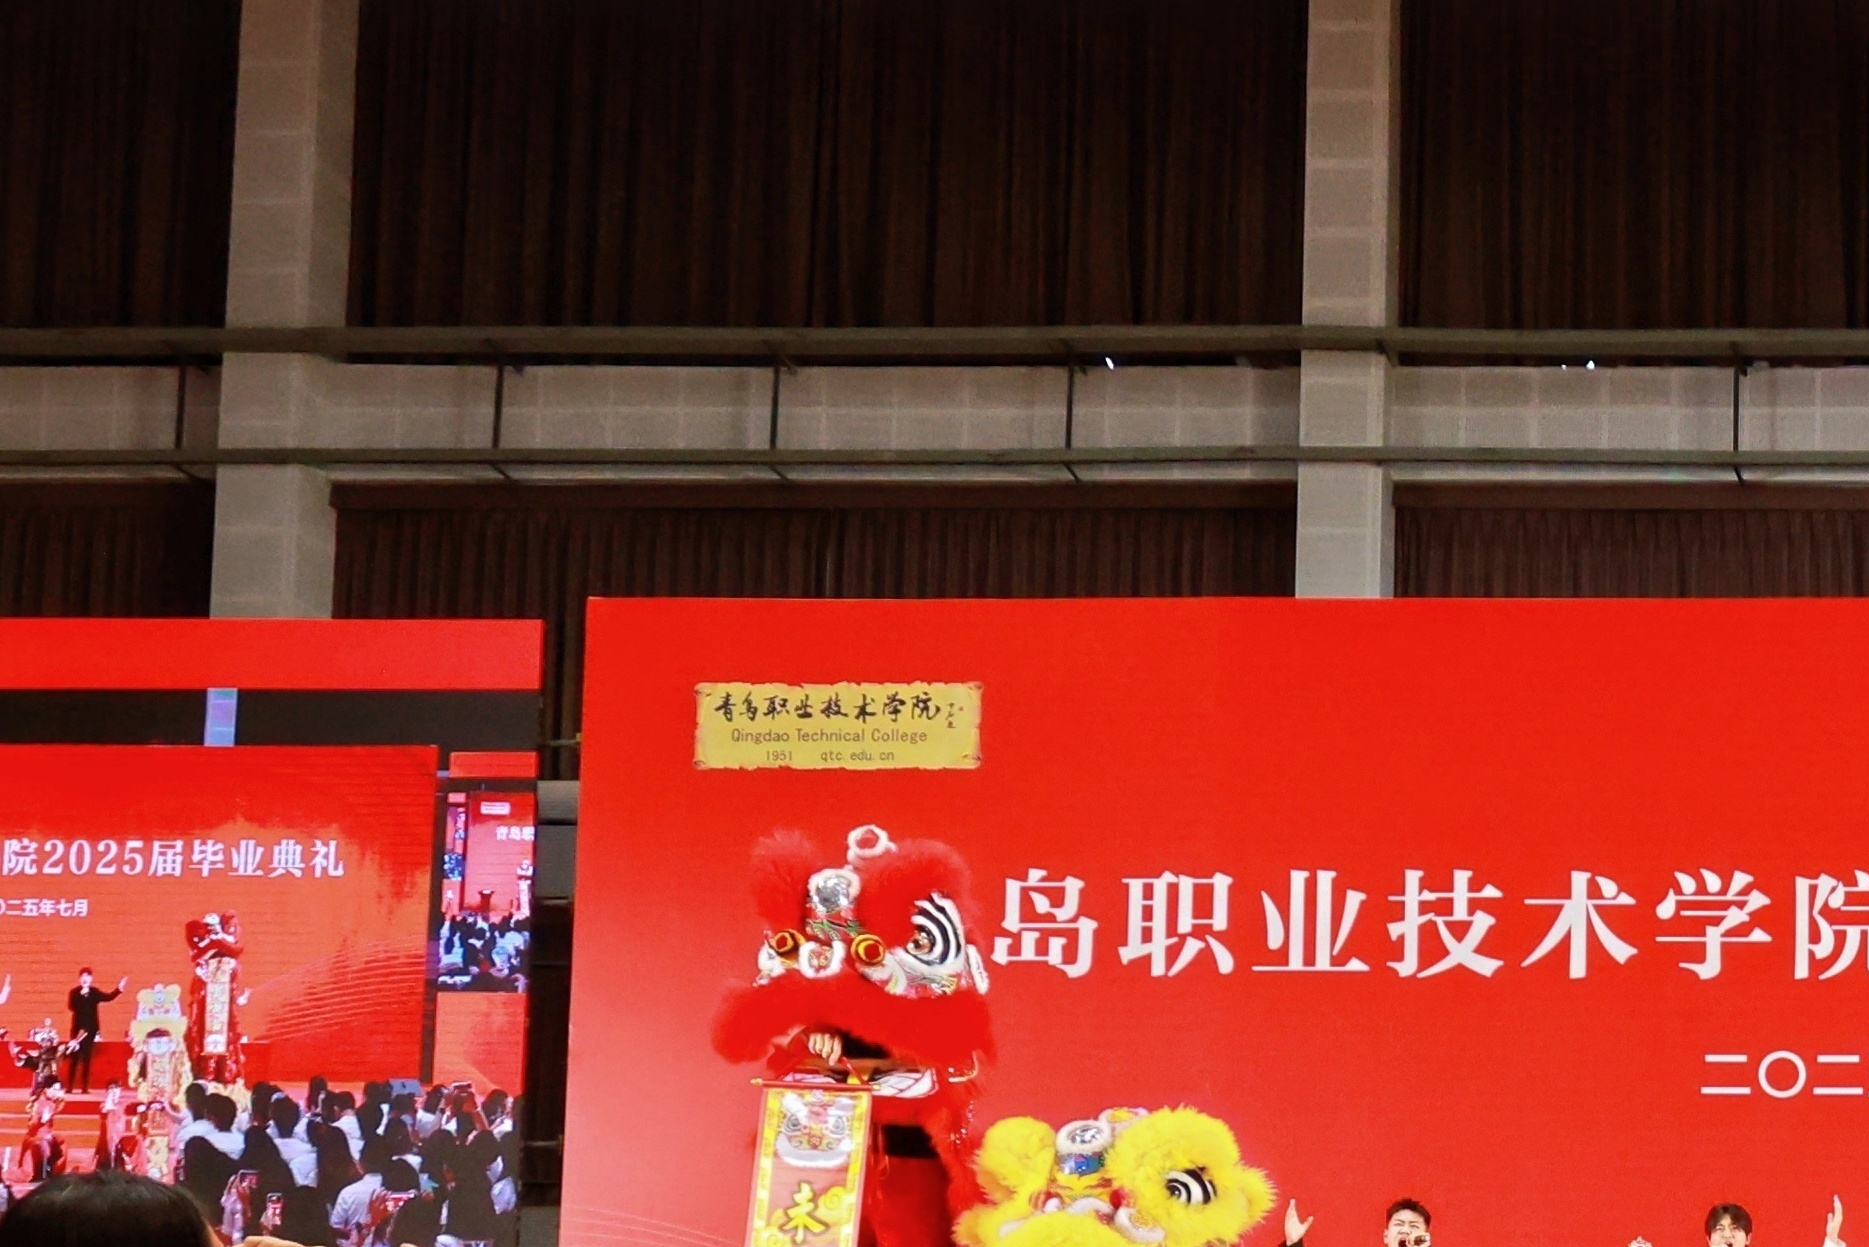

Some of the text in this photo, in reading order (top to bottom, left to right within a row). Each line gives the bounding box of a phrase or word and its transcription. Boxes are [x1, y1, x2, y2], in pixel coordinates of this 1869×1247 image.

[731, 727, 928, 744] Qingdao Technical College
[766, 750, 793, 762] 1951
[2, 838, 345, 878] 院2025届毕业典礼
